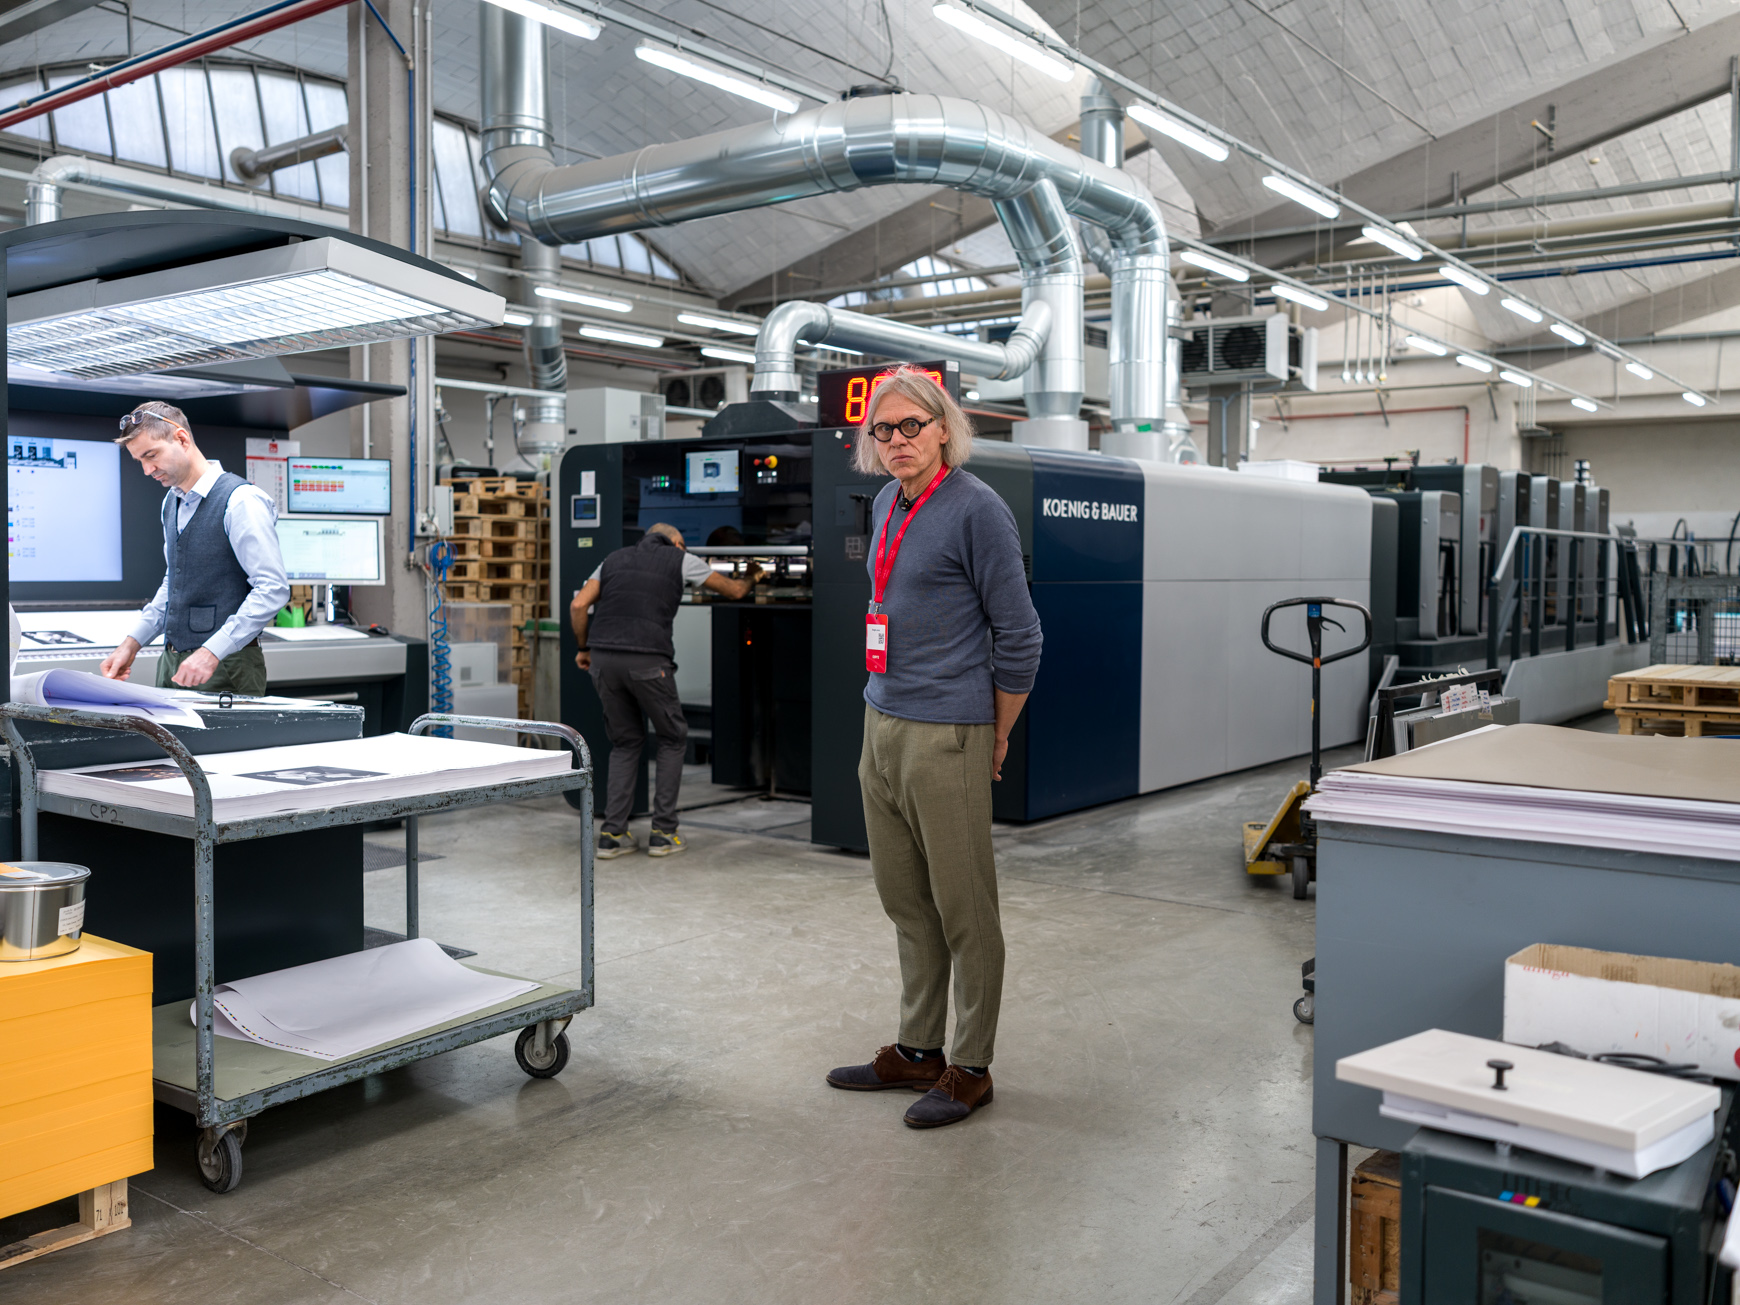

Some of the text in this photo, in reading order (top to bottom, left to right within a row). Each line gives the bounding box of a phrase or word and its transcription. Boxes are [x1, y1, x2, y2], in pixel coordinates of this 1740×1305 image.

[1043, 498, 1138, 522] KOENIG & BAUER
